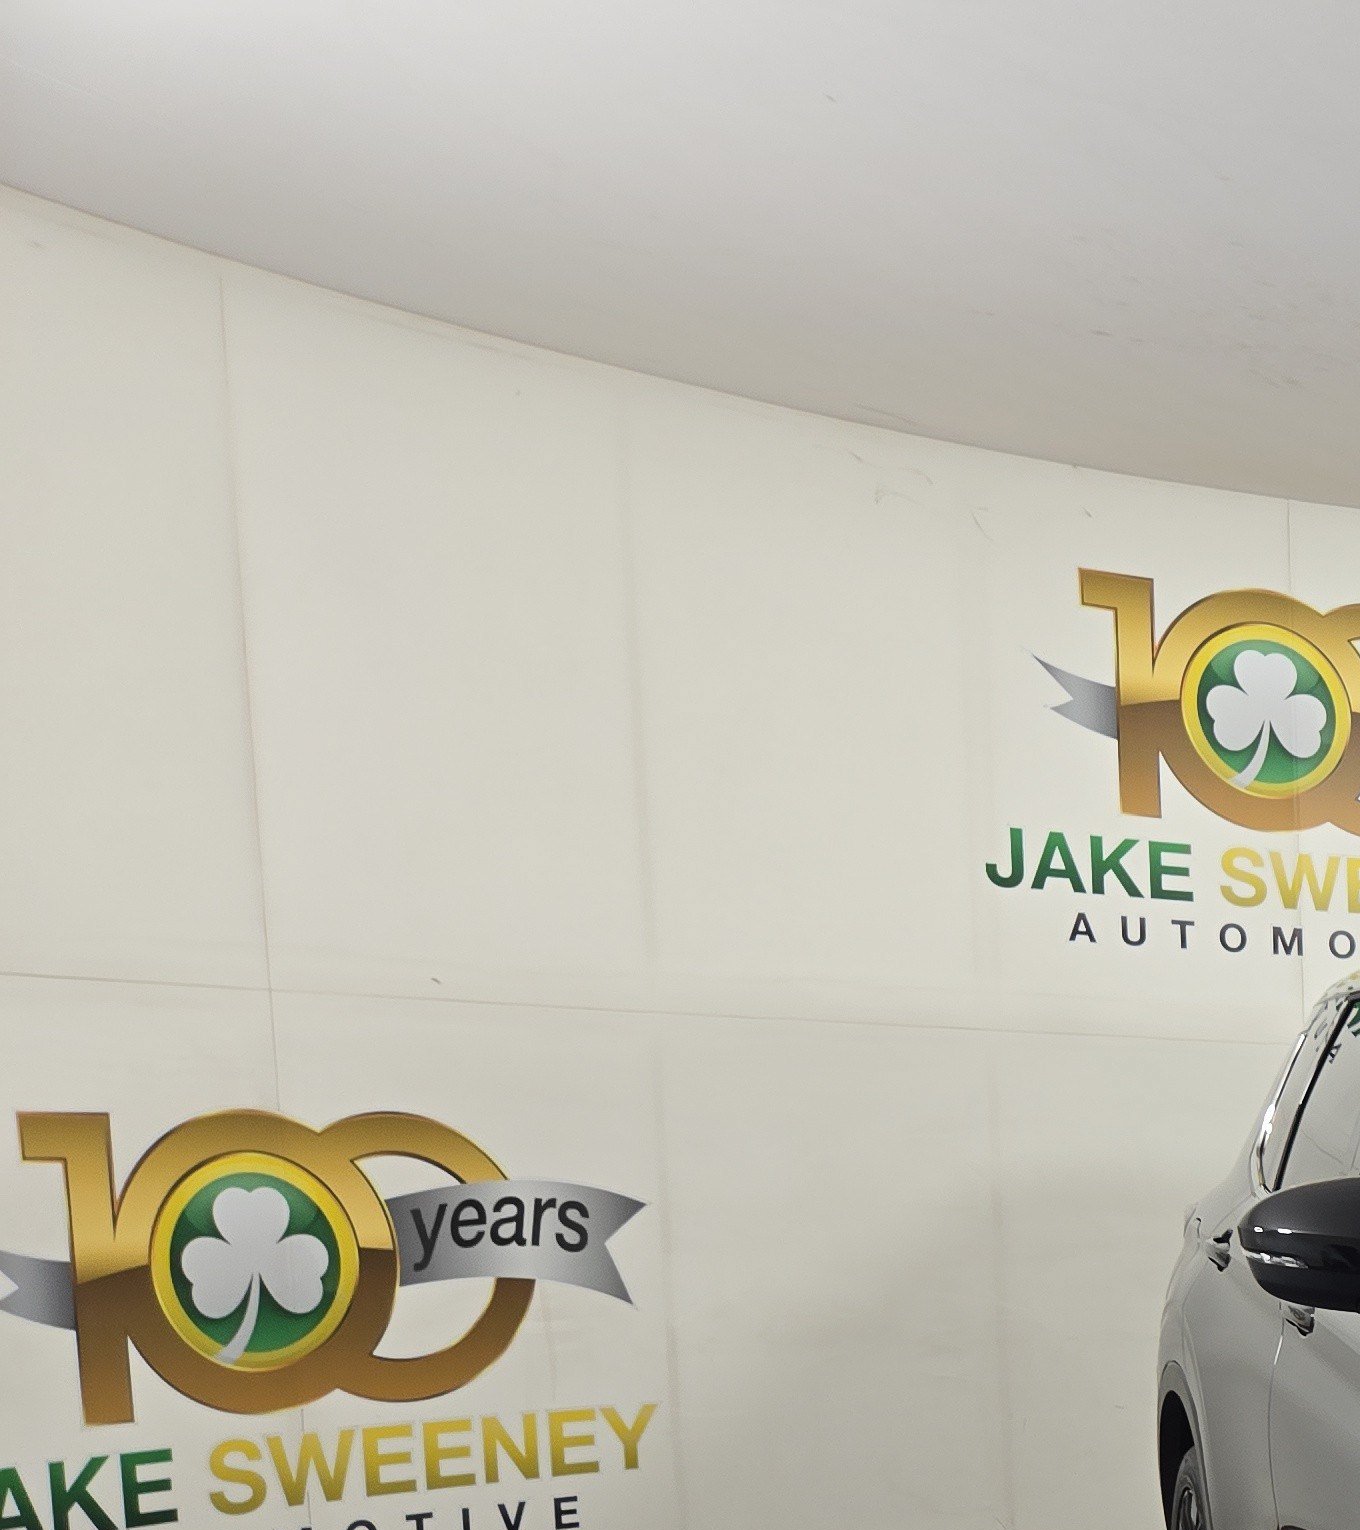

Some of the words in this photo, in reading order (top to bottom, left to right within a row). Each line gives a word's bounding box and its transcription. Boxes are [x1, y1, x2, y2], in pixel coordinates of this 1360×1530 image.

[985, 826, 1194, 902] JAKE
[410, 1194, 590, 1272] years
[208, 1404, 657, 1516] SWEENEY
